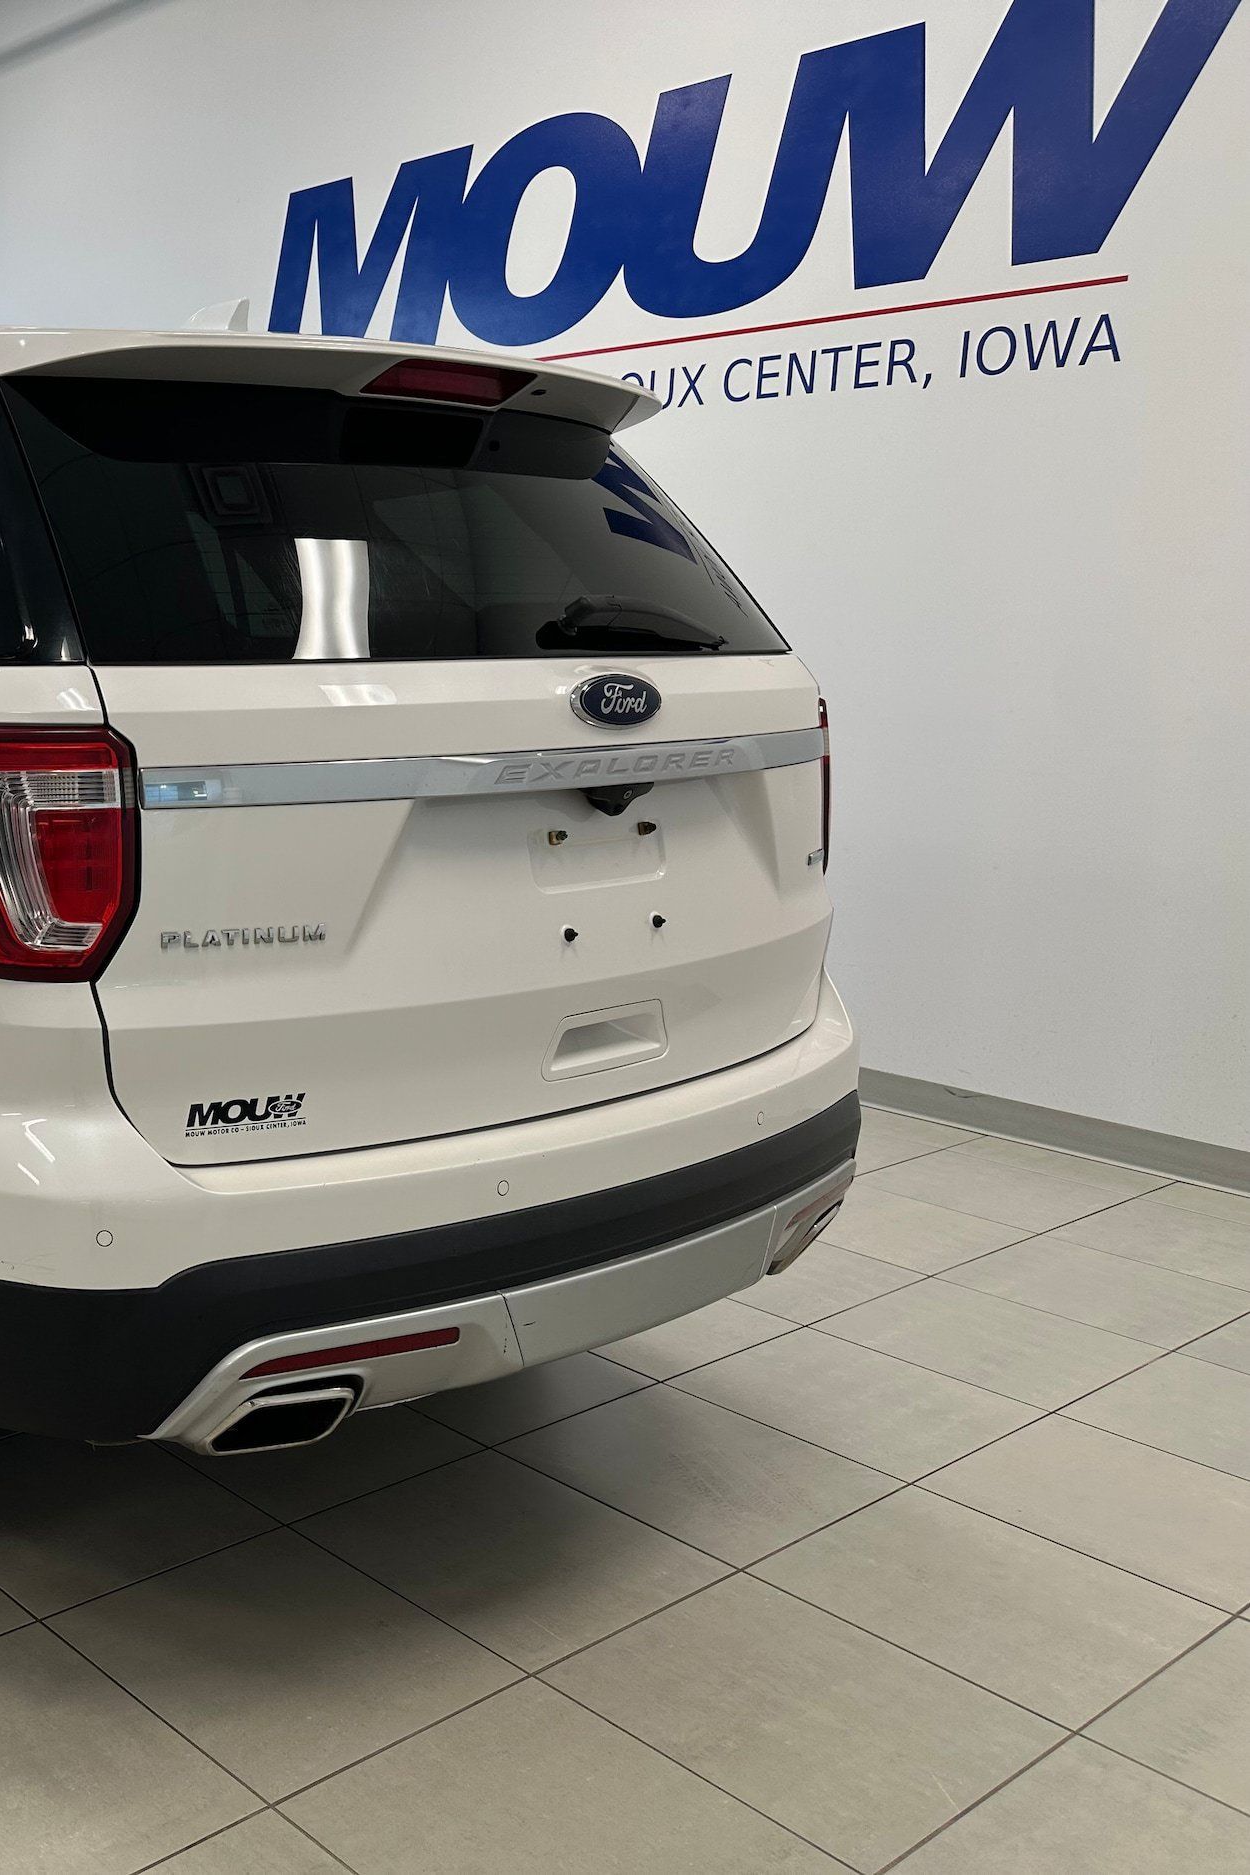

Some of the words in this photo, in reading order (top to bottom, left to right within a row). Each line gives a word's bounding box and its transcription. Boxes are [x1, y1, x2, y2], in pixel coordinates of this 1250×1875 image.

[267, 0, 1245, 347] MOUW
[723, 338, 933, 403] CENTER,
[959, 313, 1121, 379] IOWA
[600, 682, 648, 715] Ford
[493, 748, 736, 786] EXPLORER
[160, 922, 328, 951] PLATINUM
